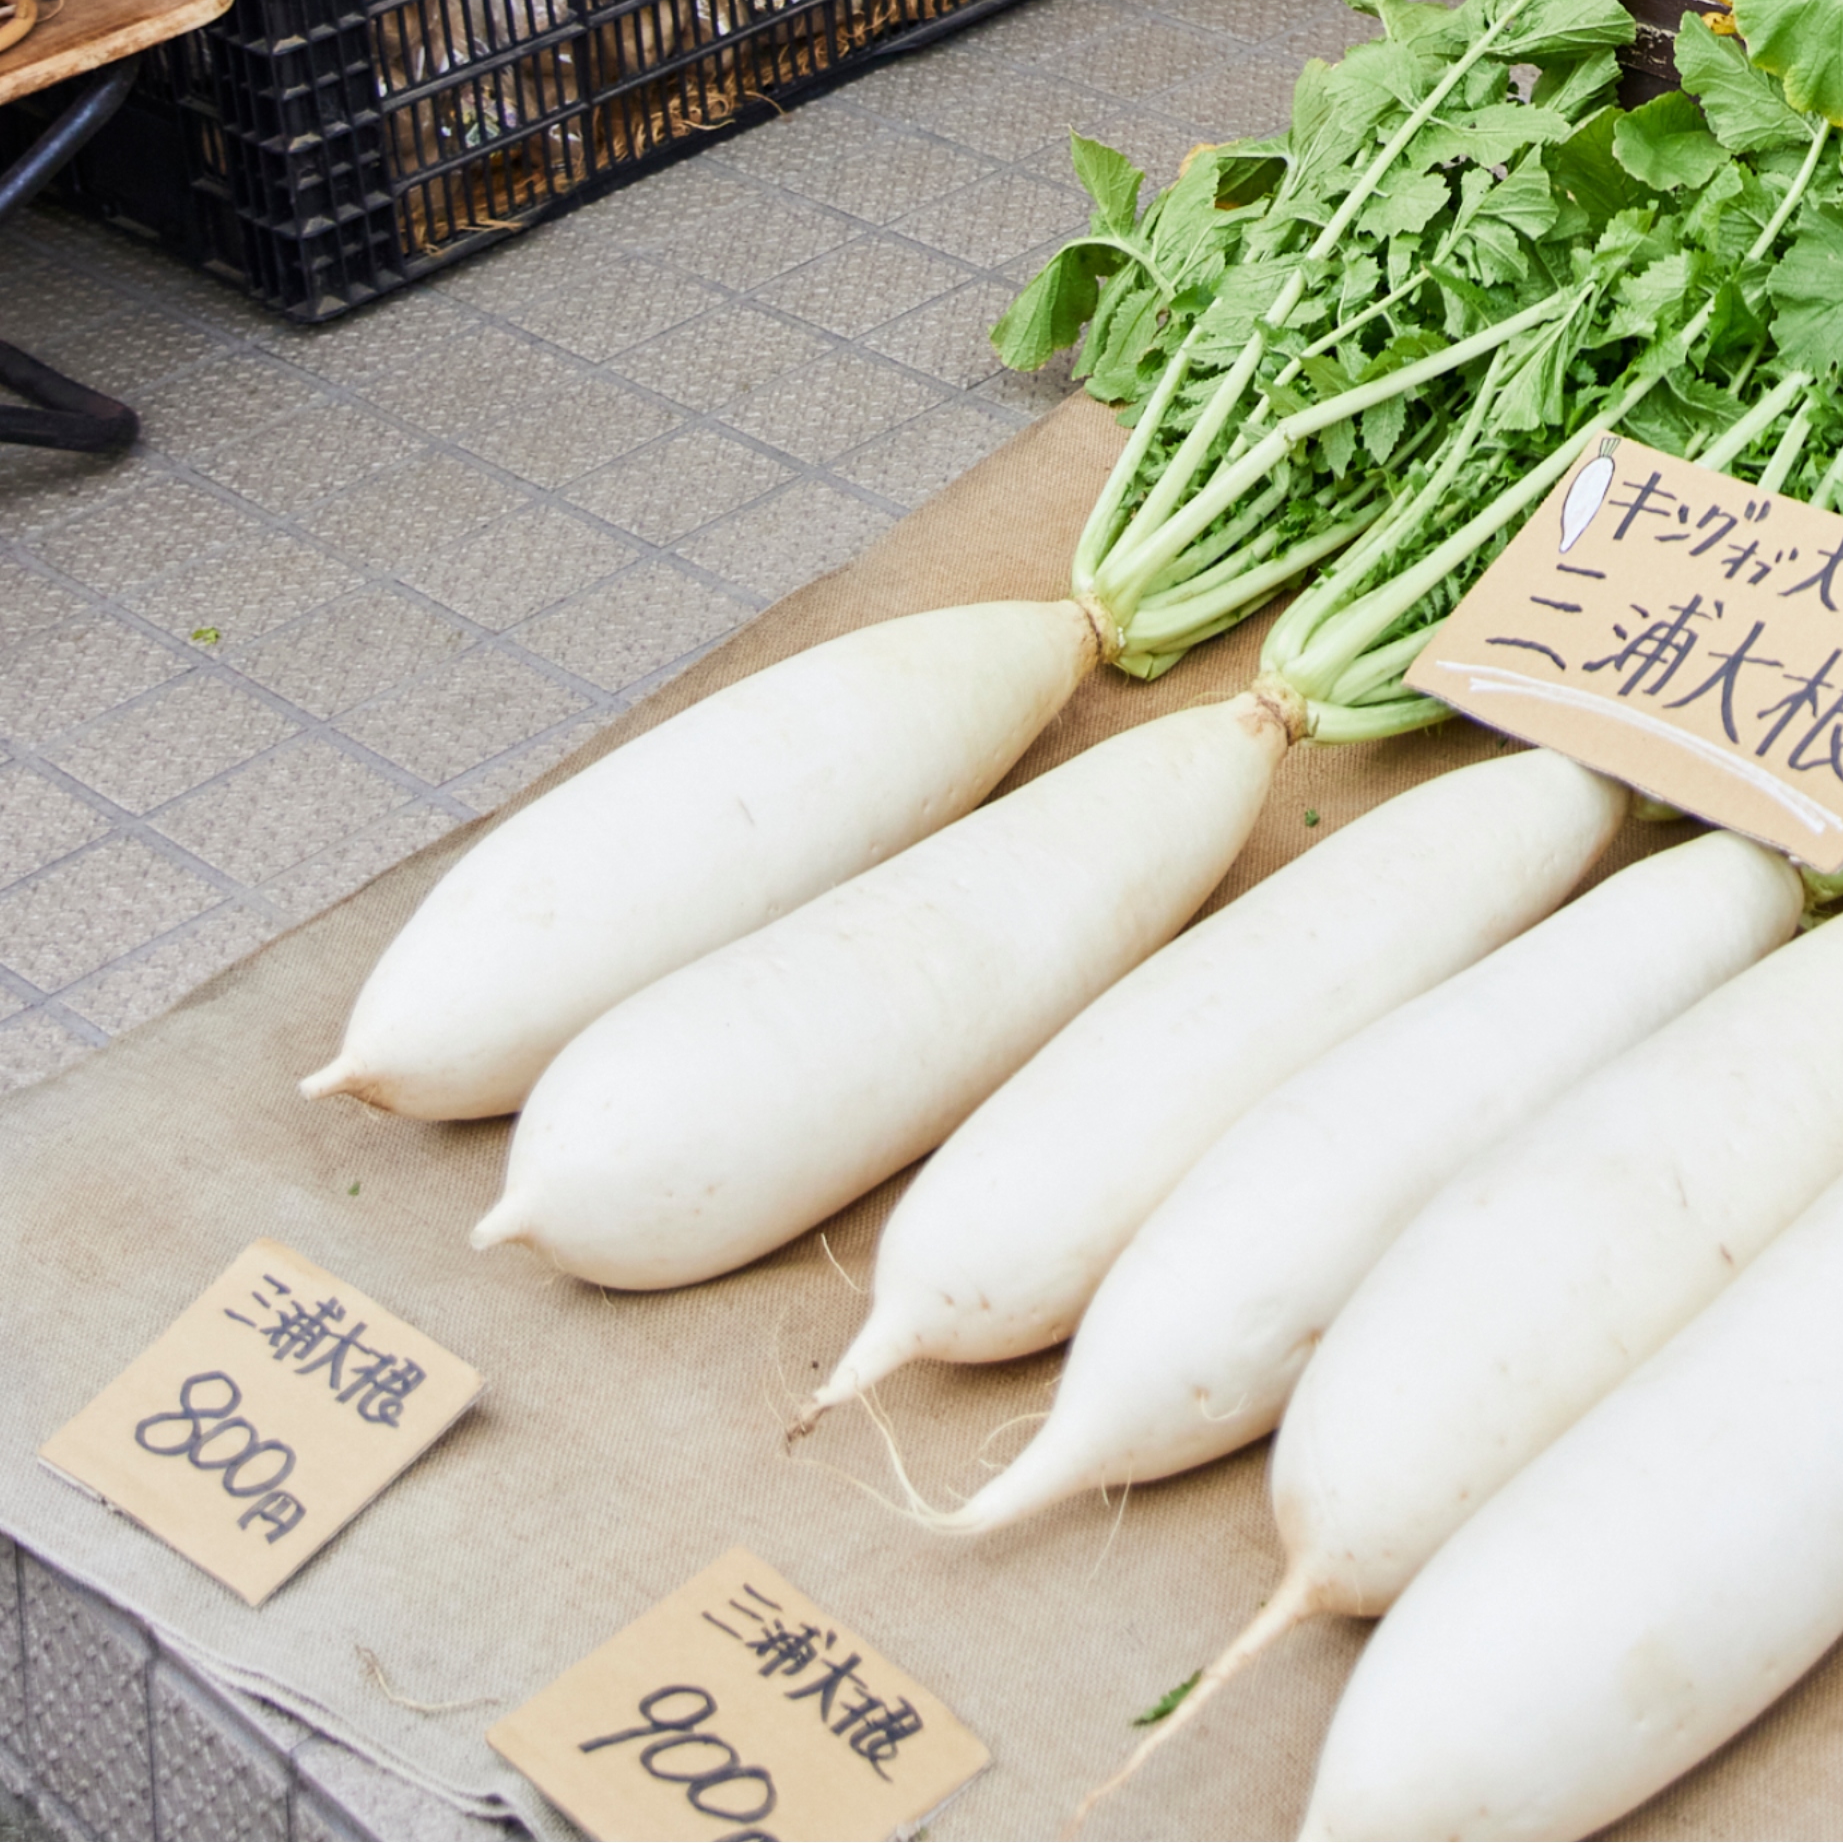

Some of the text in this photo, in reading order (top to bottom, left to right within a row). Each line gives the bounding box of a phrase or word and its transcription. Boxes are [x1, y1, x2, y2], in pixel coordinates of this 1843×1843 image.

[223, 1273, 427, 1428] 三浦大根
[134, 1370, 307, 1545] 800円
[578, 1684, 778, 1843] 900
[701, 1582, 924, 1784] 三浦大根
